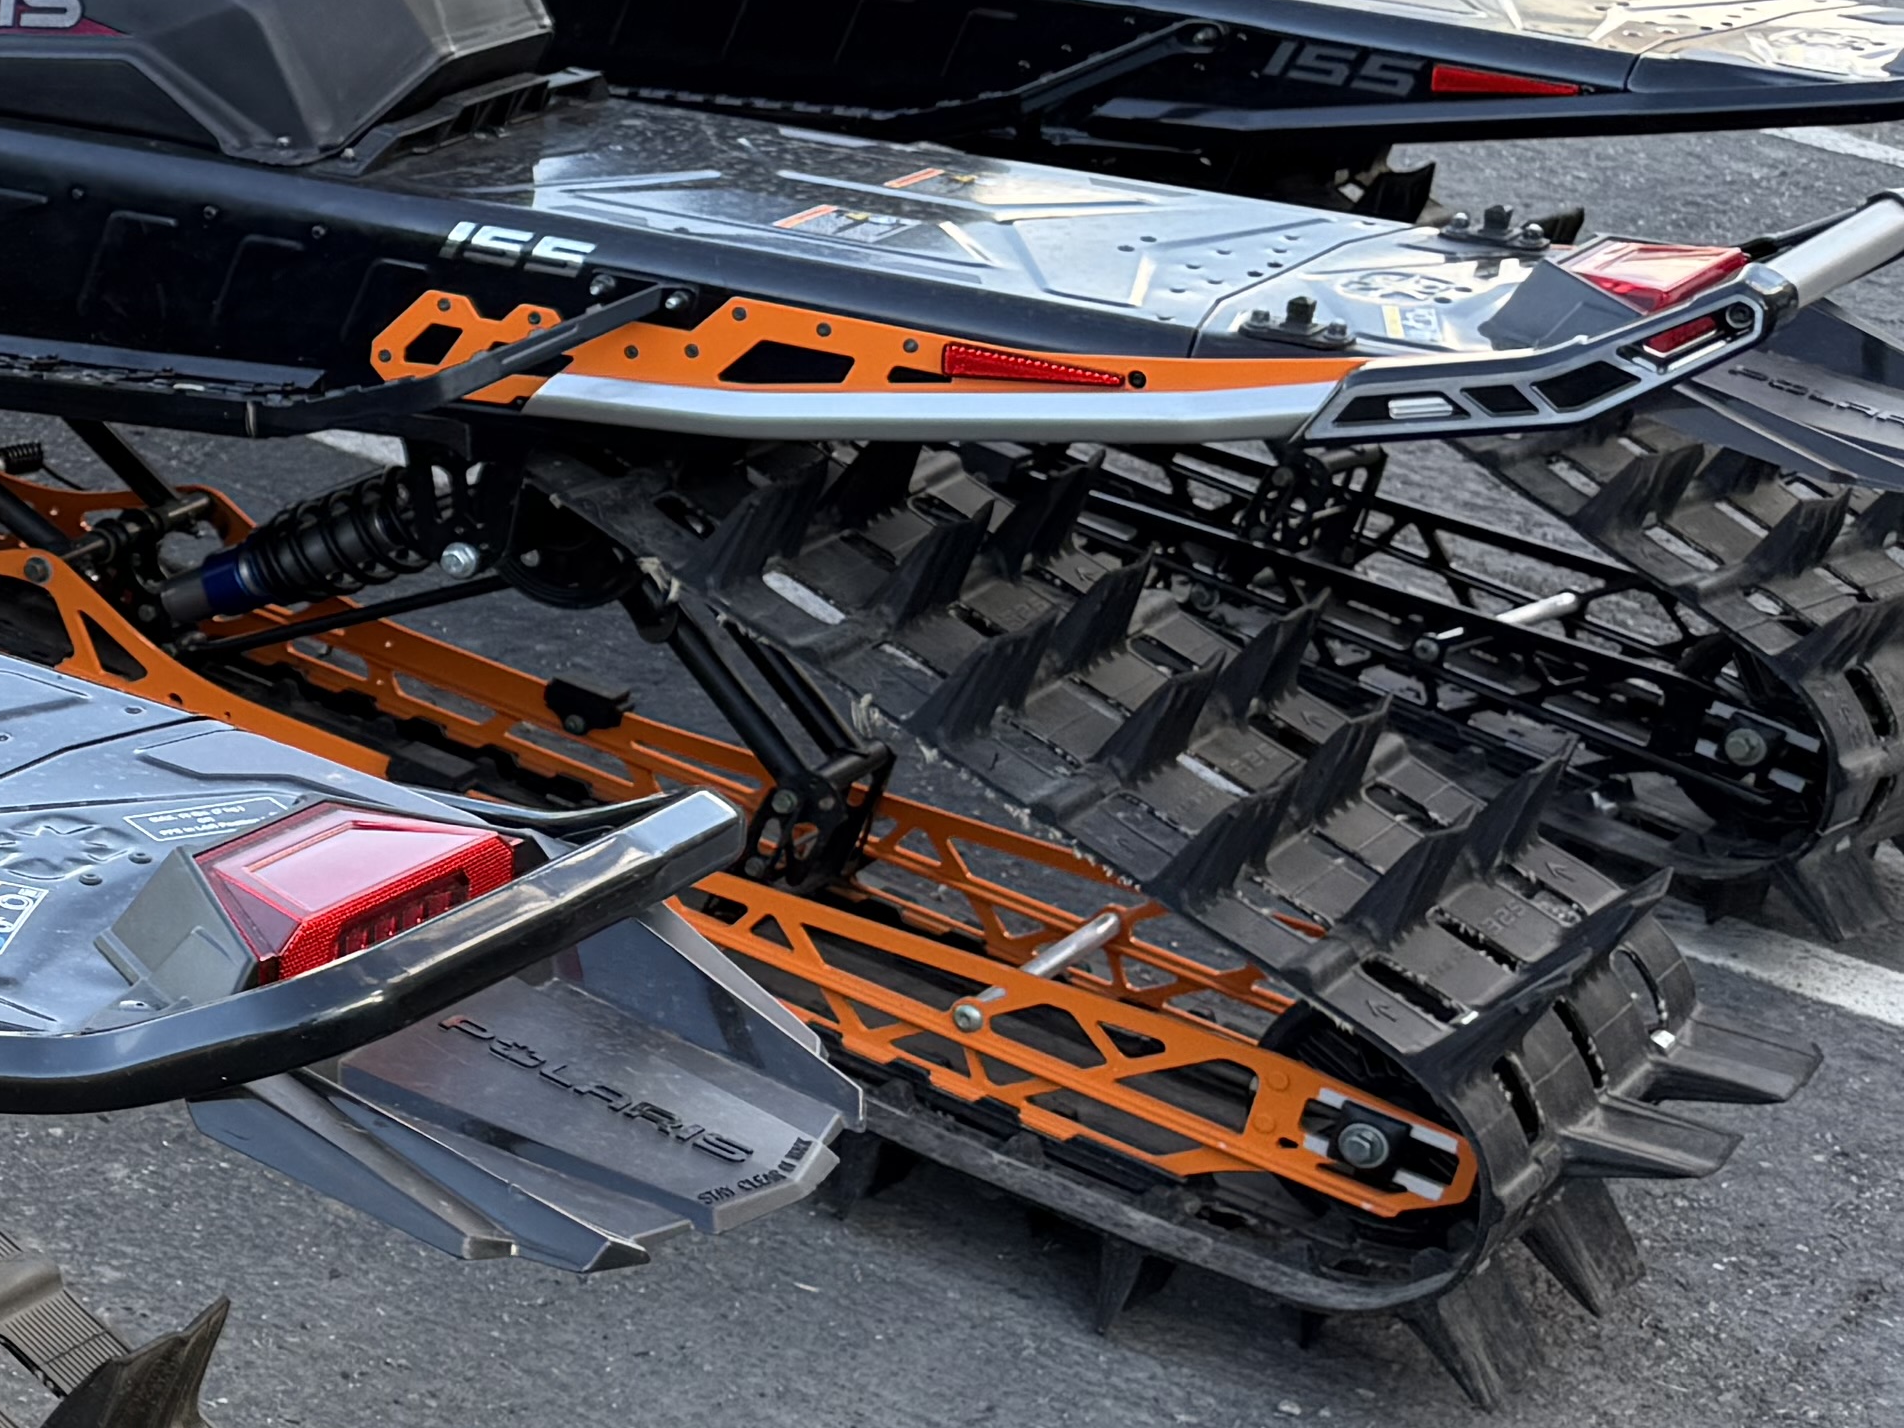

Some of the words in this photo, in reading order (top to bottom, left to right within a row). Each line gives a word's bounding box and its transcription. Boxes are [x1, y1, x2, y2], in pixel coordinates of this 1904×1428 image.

[1263, 41, 1425, 98] 155
[438, 221, 597, 277] 155
[1727, 364, 1904, 428] POLAR
[438, 1016, 754, 1163] POLARIS
[697, 1185, 736, 1206] STAY
[737, 1169, 788, 1192] CLEAR
